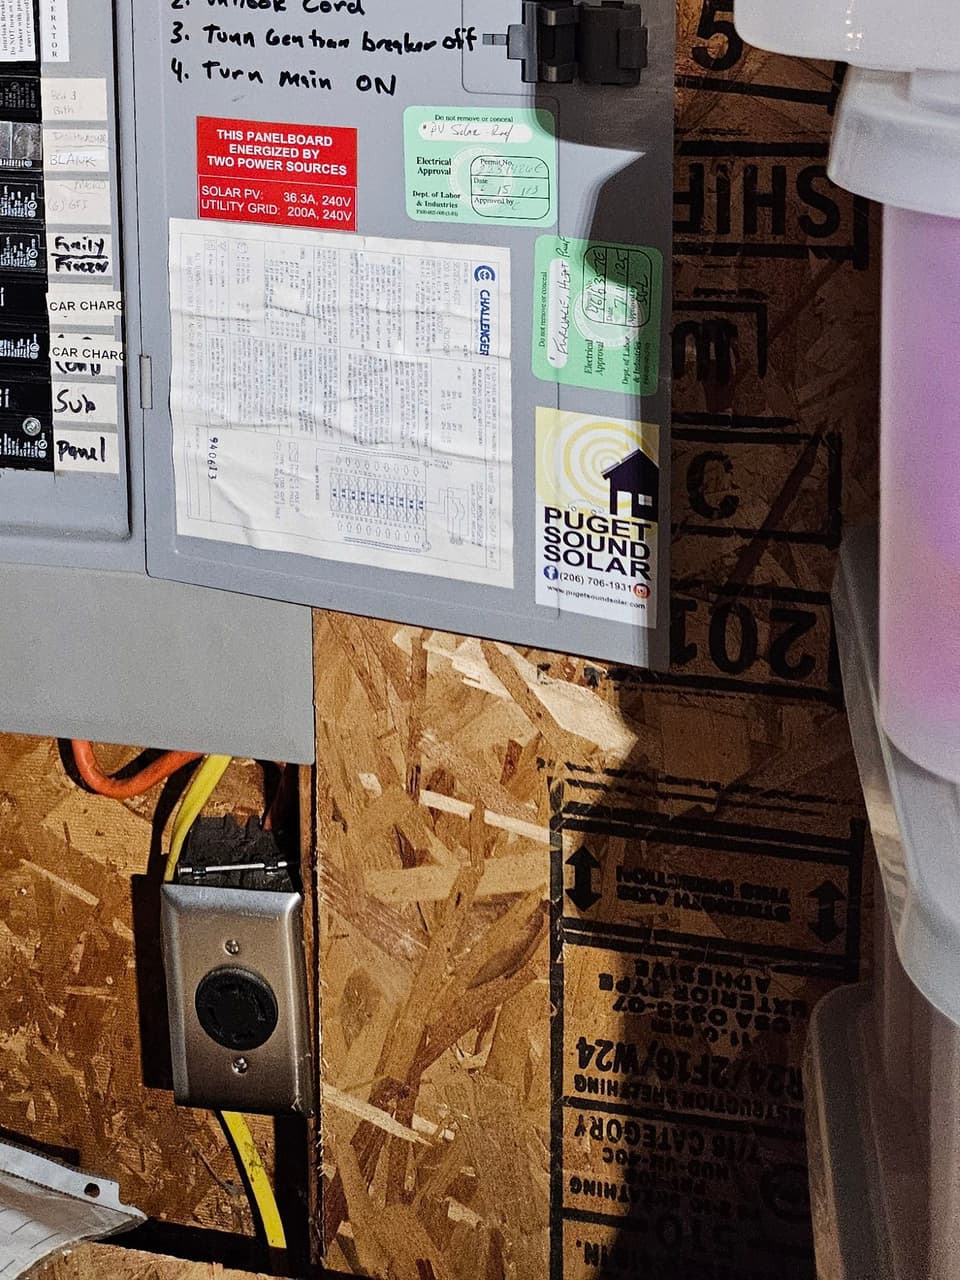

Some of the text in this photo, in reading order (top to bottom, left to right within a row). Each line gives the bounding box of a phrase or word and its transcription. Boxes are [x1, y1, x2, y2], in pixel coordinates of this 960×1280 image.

[170, 21, 190, 44] 3.
[361, 30, 437, 55] breaker
[442, 26, 477, 51] off
[170, 57, 396, 96] 4. Turn main ON
[216, 128, 333, 147] THIS PANELBOARD
[229, 144, 320, 160] ENERGIZED BY
[416, 156, 452, 166] Electrical
[480, 158, 501, 167] Permit
[207, 155, 347, 176] TWO POWER SOURCES
[417, 167, 452, 177] Approval
[201, 185, 352, 208] SOLAR PV: 36.3A, 240V
[412, 190, 430, 199] Dept.
[440, 191, 461, 199] Labor
[424, 200, 459, 209] Industries
[201, 199, 352, 221] UTILITY GRID: 200A, 240V
[49, 301, 76, 311] CAR
[477, 288, 492, 357] CHALLENGER
[52, 347, 78, 358] CAR
[54, 388, 97, 414] Sub
[206, 436, 219, 481] 940613
[543, 505, 651, 543] PUGET
[543, 526, 651, 561] SOUND
[543, 543, 652, 582] SOLAR
[559, 571, 632, 593] (206) 706-1931
[546, 584, 646, 610] www.pugetsoundsolar.com
[574, 1114, 706, 1158] CATEGORY
